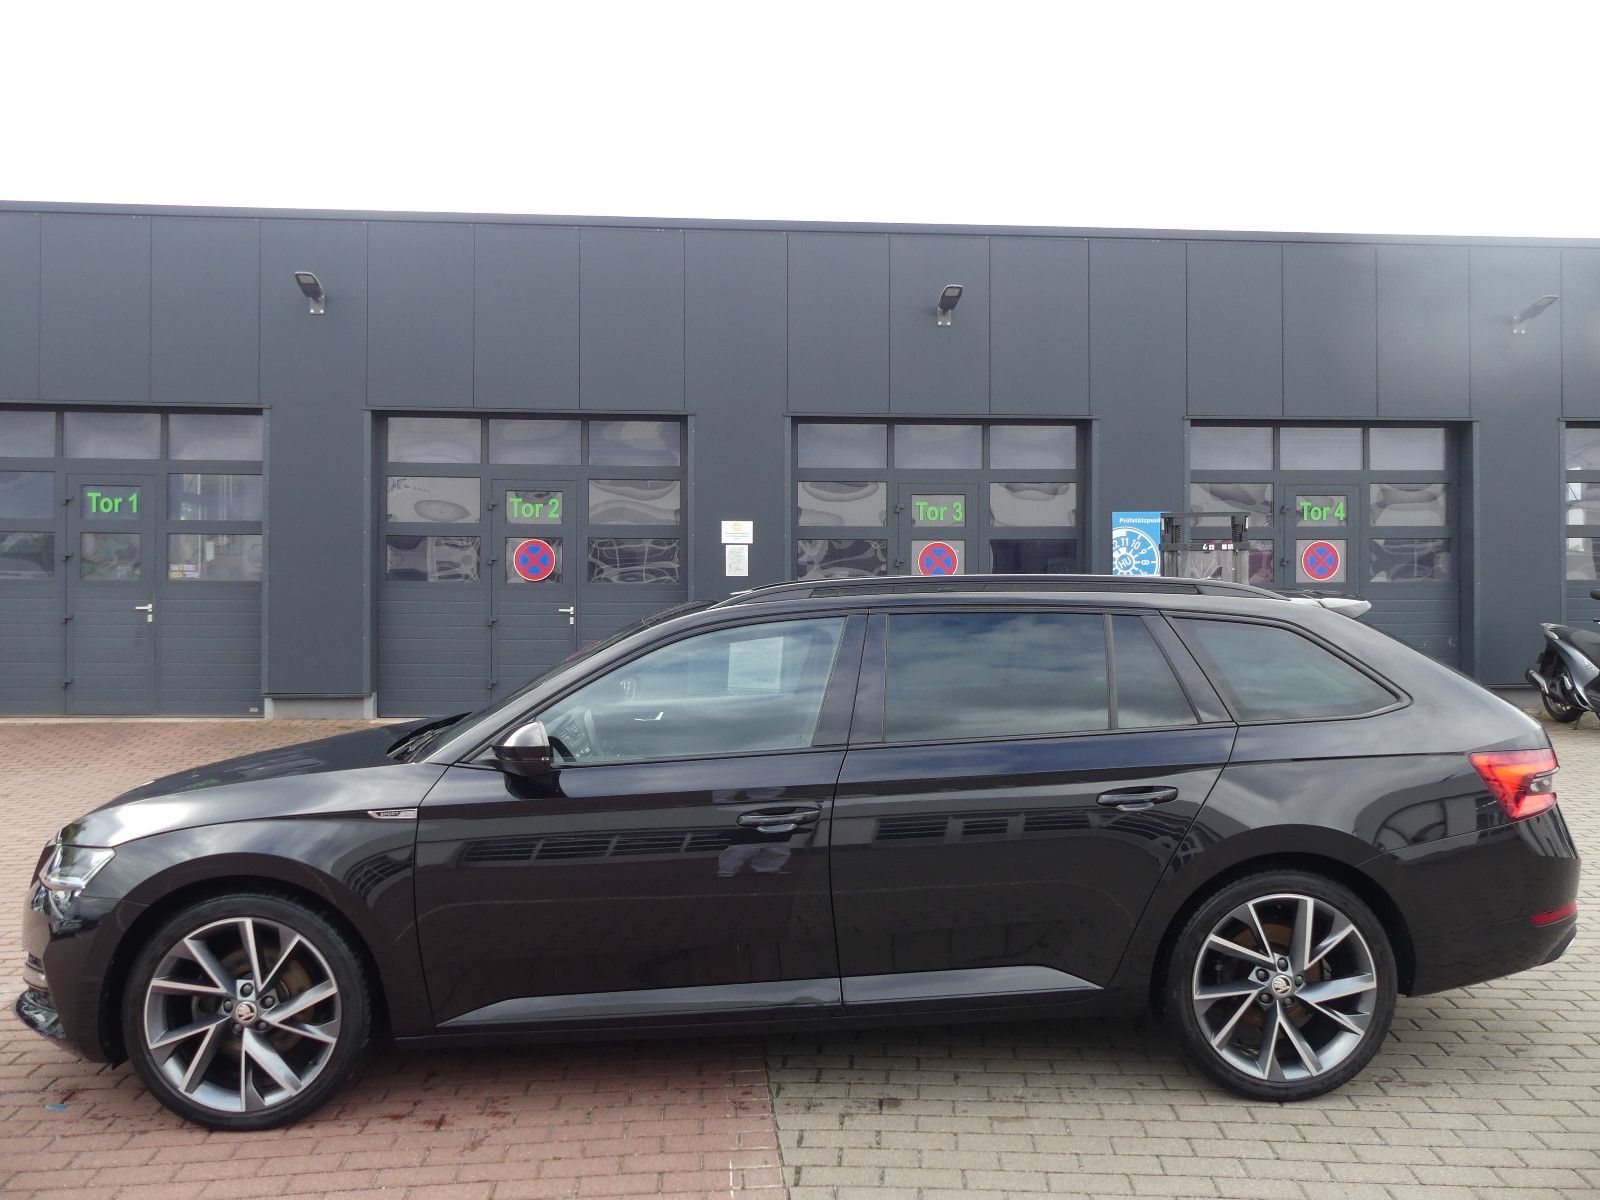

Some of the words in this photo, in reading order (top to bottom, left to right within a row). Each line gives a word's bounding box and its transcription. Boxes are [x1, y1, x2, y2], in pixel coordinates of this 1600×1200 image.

[87, 492, 123, 513] Tor
[129, 493, 138, 513] 1
[511, 497, 544, 518] Tor
[548, 498, 560, 518] 2
[915, 501, 948, 521] Tor
[952, 501, 963, 521] 3
[1300, 501, 1330, 521] Tor
[1334, 501, 1345, 521] 4
[1120, 537, 1129, 547] 11
[1130, 539, 1141, 550] 10
[1118, 556, 1132, 569] HU
